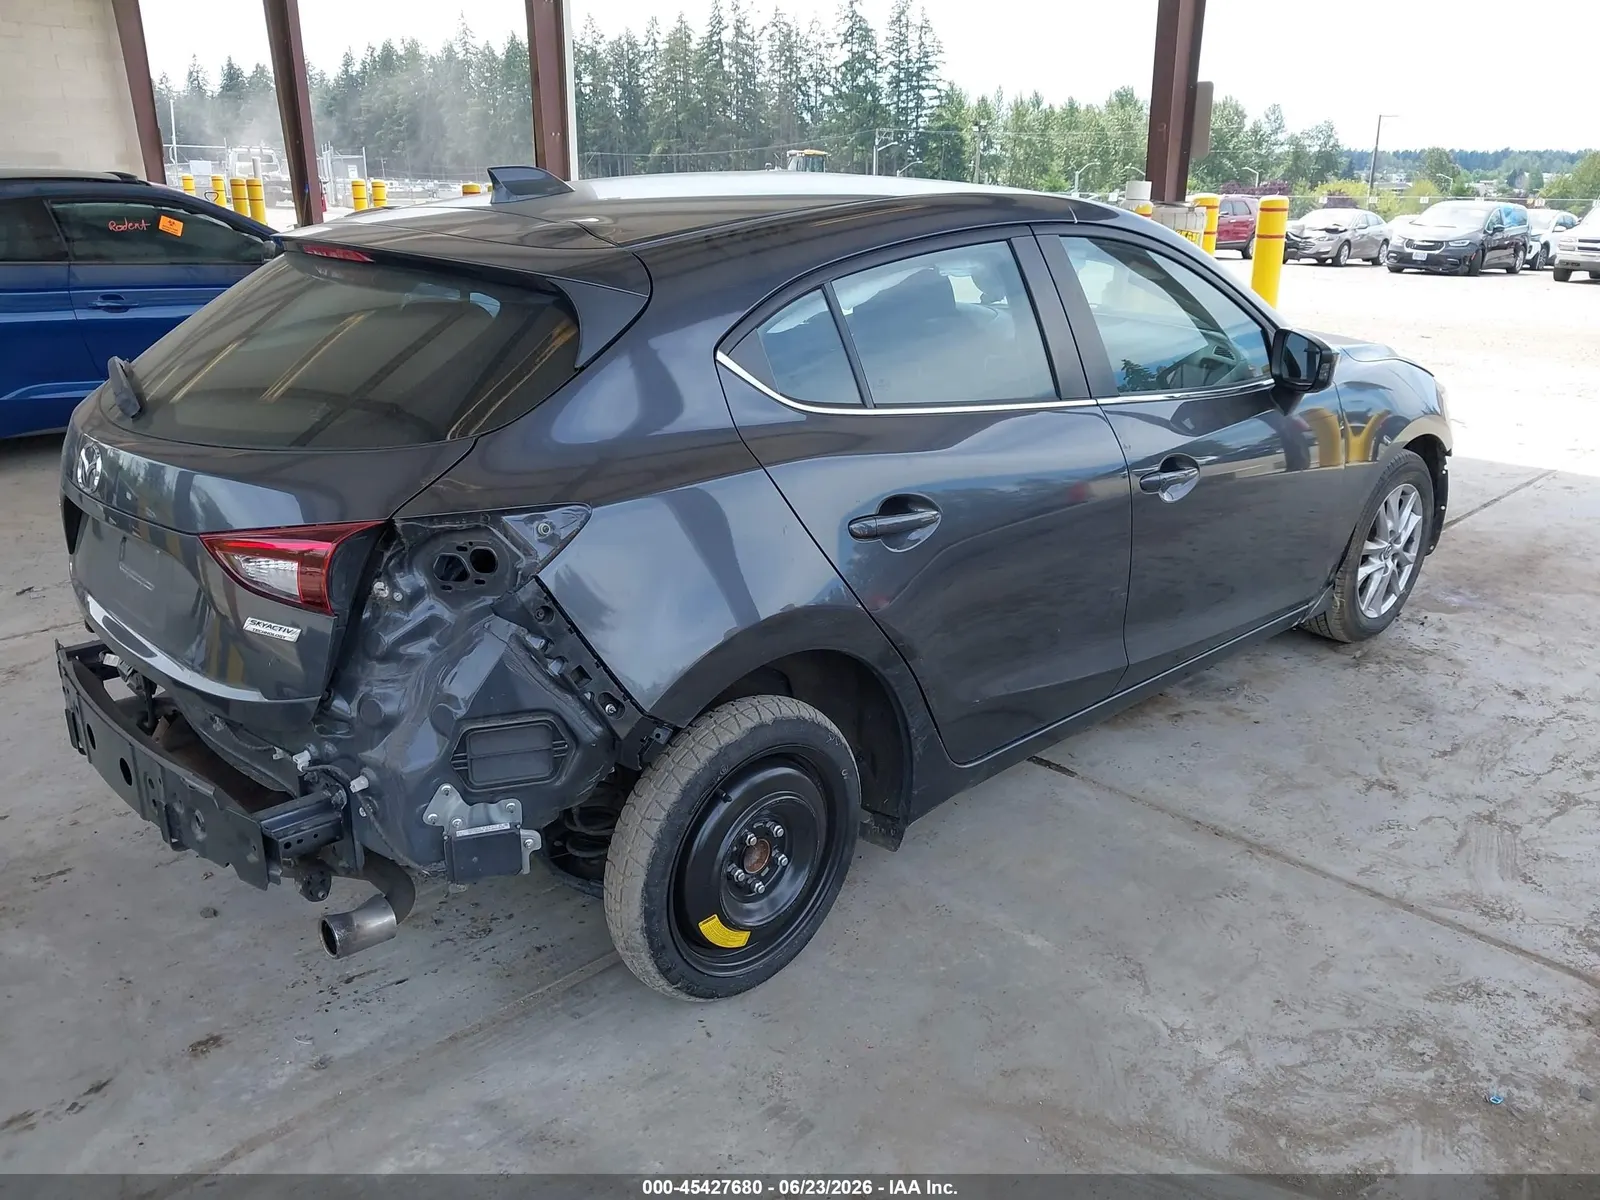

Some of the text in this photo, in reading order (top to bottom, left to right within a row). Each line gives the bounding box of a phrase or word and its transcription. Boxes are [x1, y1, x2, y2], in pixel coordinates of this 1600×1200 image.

[108, 216, 151, 232] Rodent
[249, 619, 294, 634] SKYACTIV
[252, 628, 287, 640] TECHNOLOGY
